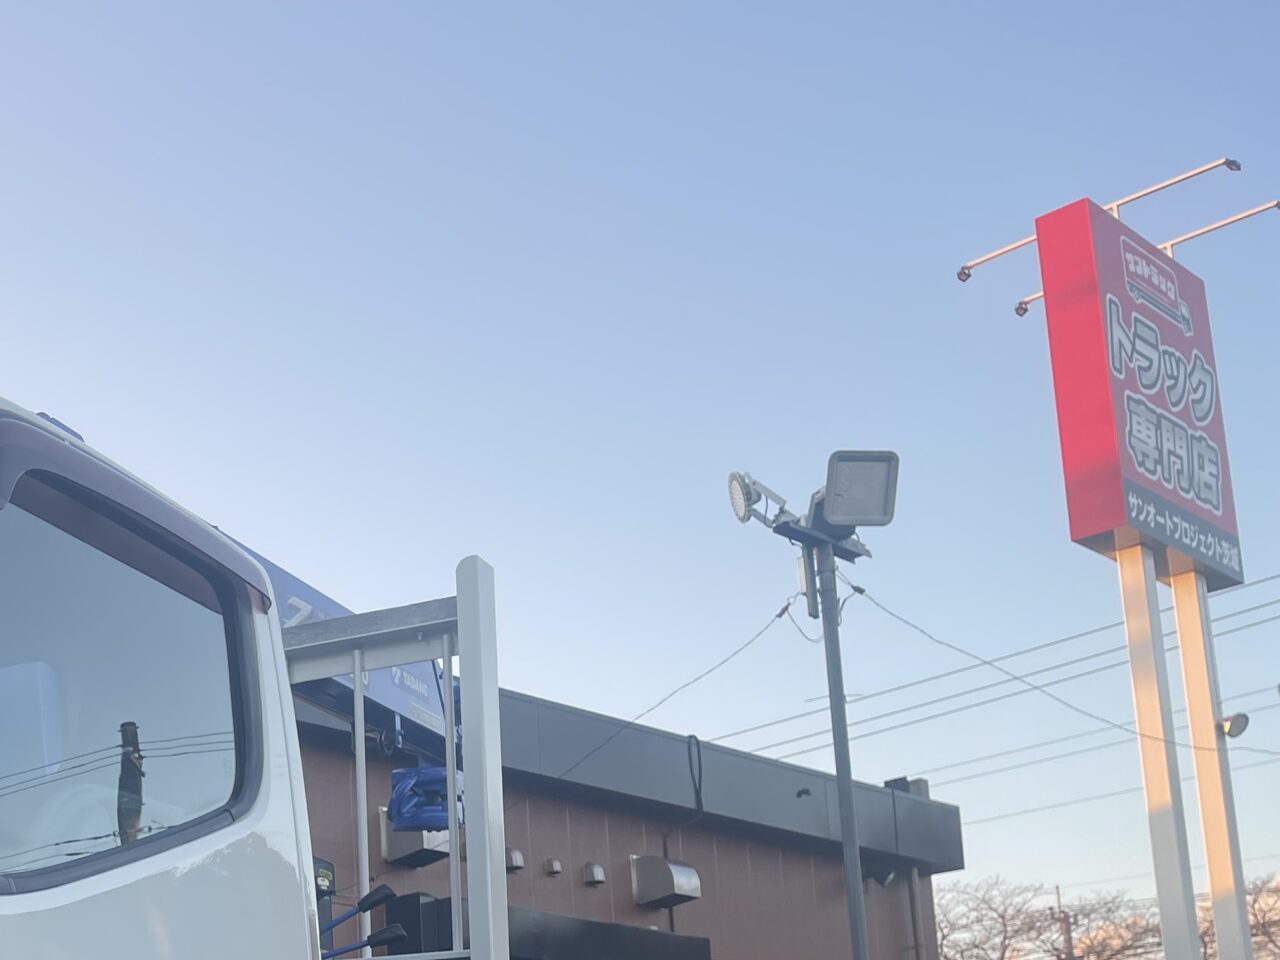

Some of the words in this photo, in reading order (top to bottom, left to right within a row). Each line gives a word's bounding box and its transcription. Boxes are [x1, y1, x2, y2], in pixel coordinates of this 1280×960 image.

[1125, 252, 1176, 301] サントラック
[1107, 293, 1216, 427] トラック
[1125, 390, 1222, 516] 専門店
